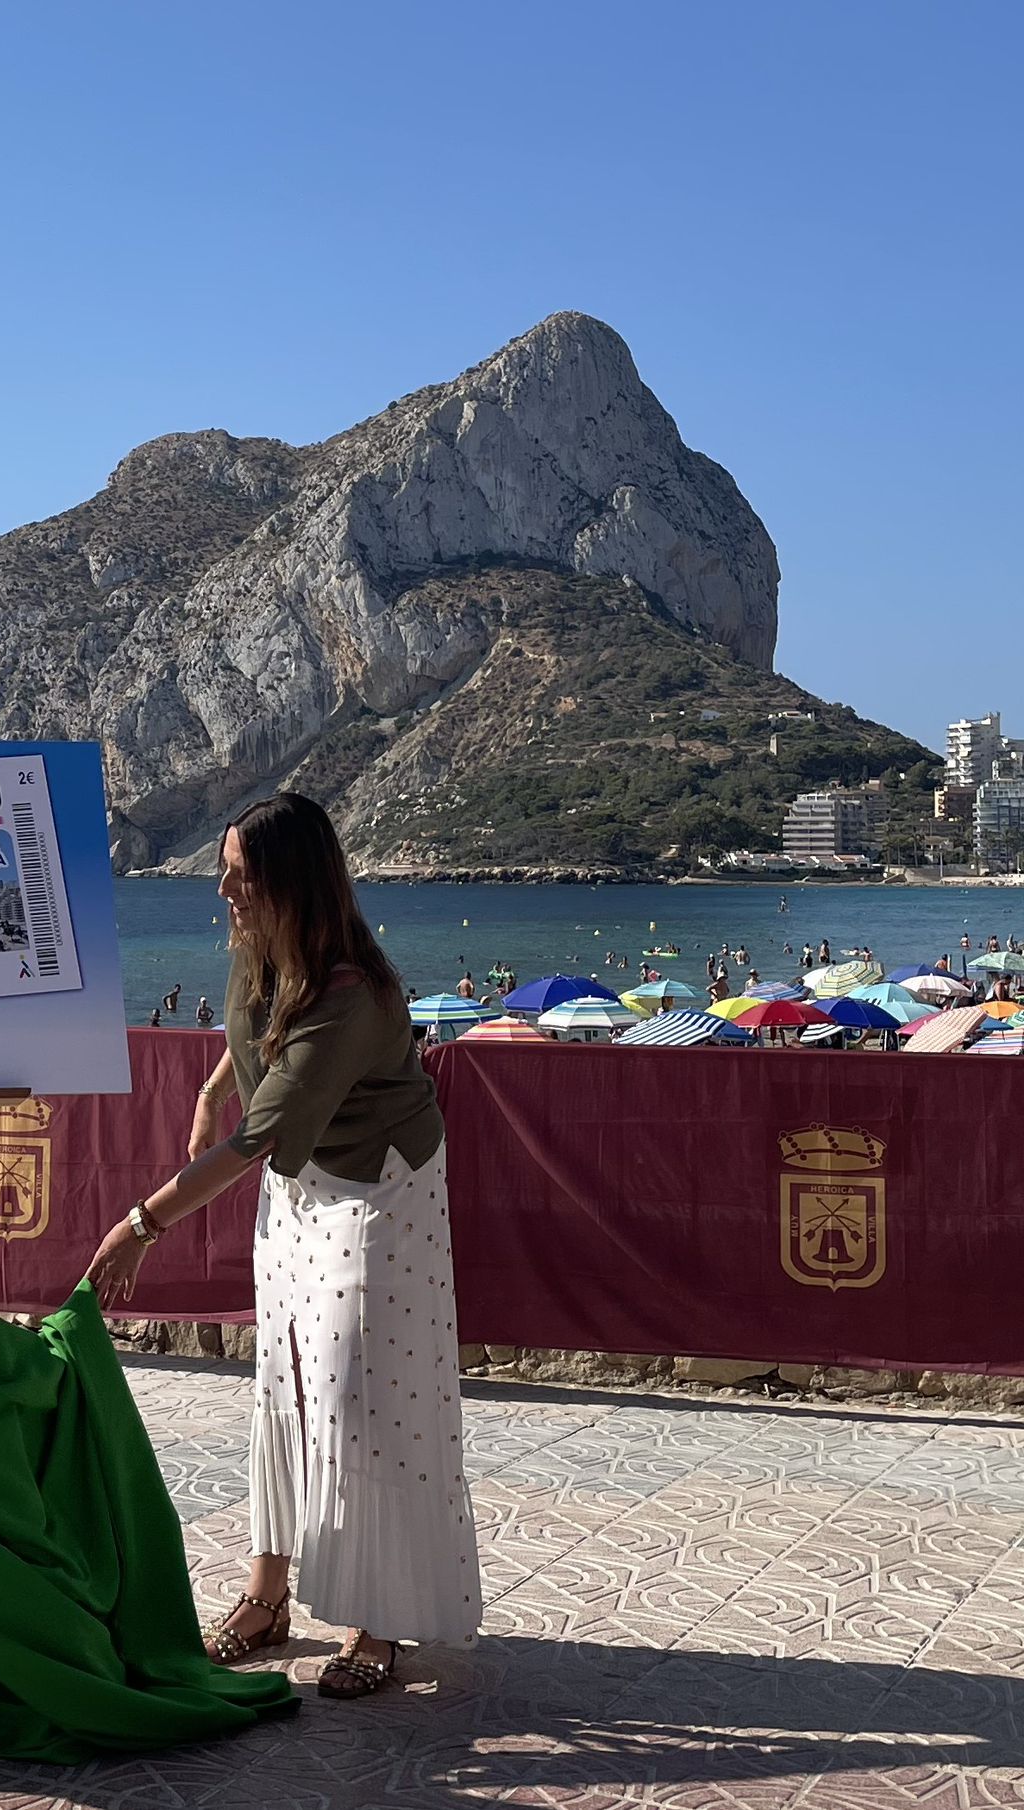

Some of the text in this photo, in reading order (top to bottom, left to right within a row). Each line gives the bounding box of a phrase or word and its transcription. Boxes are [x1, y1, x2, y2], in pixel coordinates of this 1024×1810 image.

[18, 771, 35, 785] 2€
[810, 1186, 854, 1194] HEROICA
[791, 1215, 799, 1238] MUY
